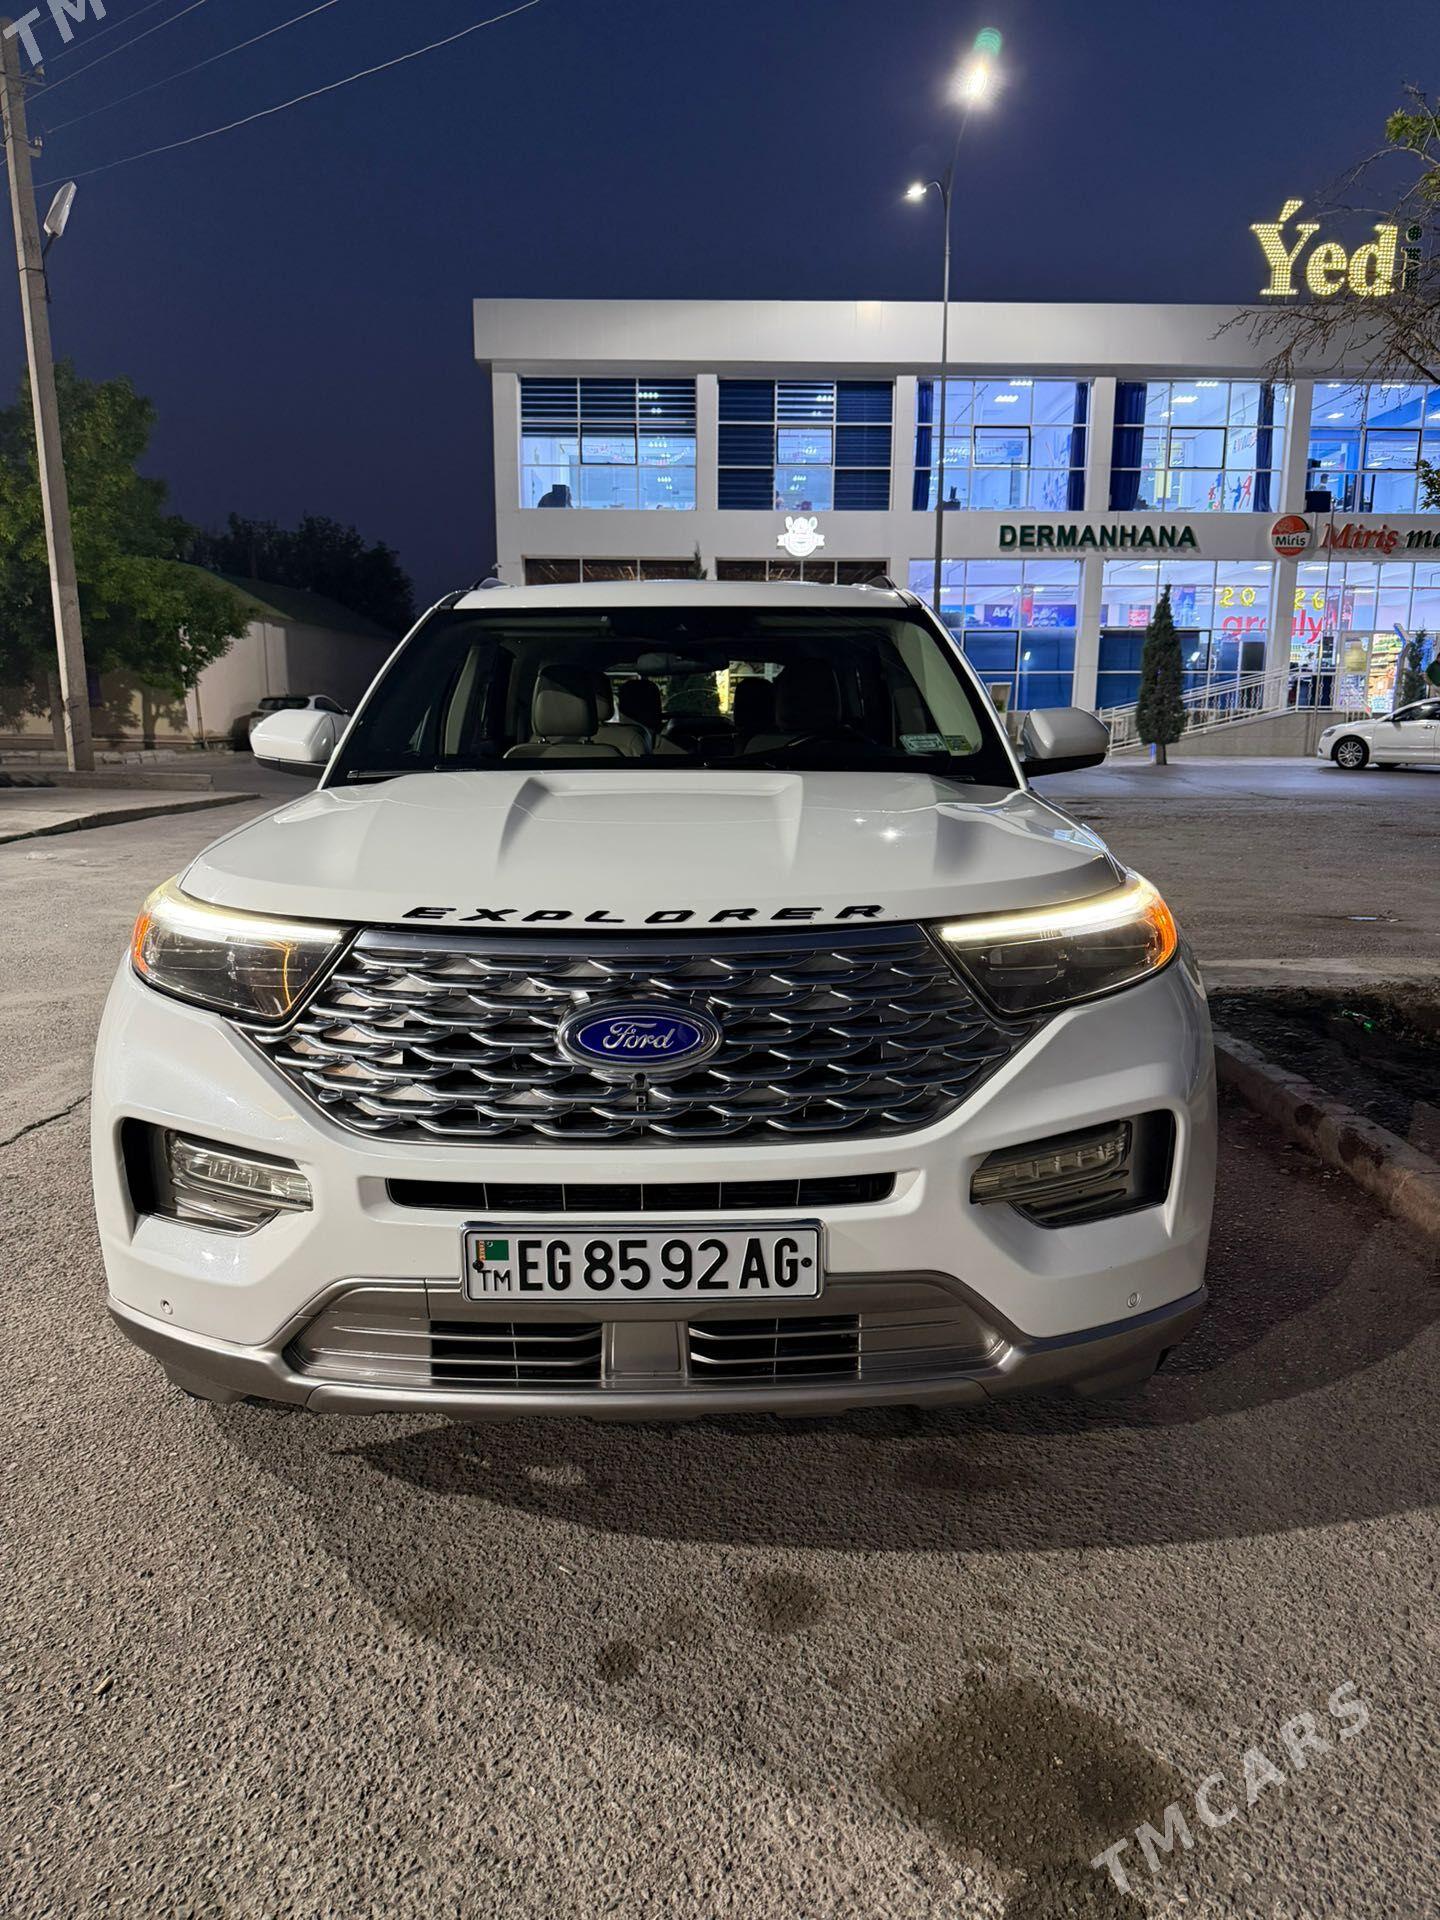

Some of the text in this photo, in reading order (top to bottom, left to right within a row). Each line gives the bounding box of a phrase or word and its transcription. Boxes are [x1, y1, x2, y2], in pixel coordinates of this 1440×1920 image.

[1000, 525, 1197, 548] DERMANHANA
[1319, 523, 1398, 554] Miriş
[402, 904, 883, 924] EXPLORER
[602, 1022, 674, 1050] Ford
[477, 1270, 511, 1291] TM
